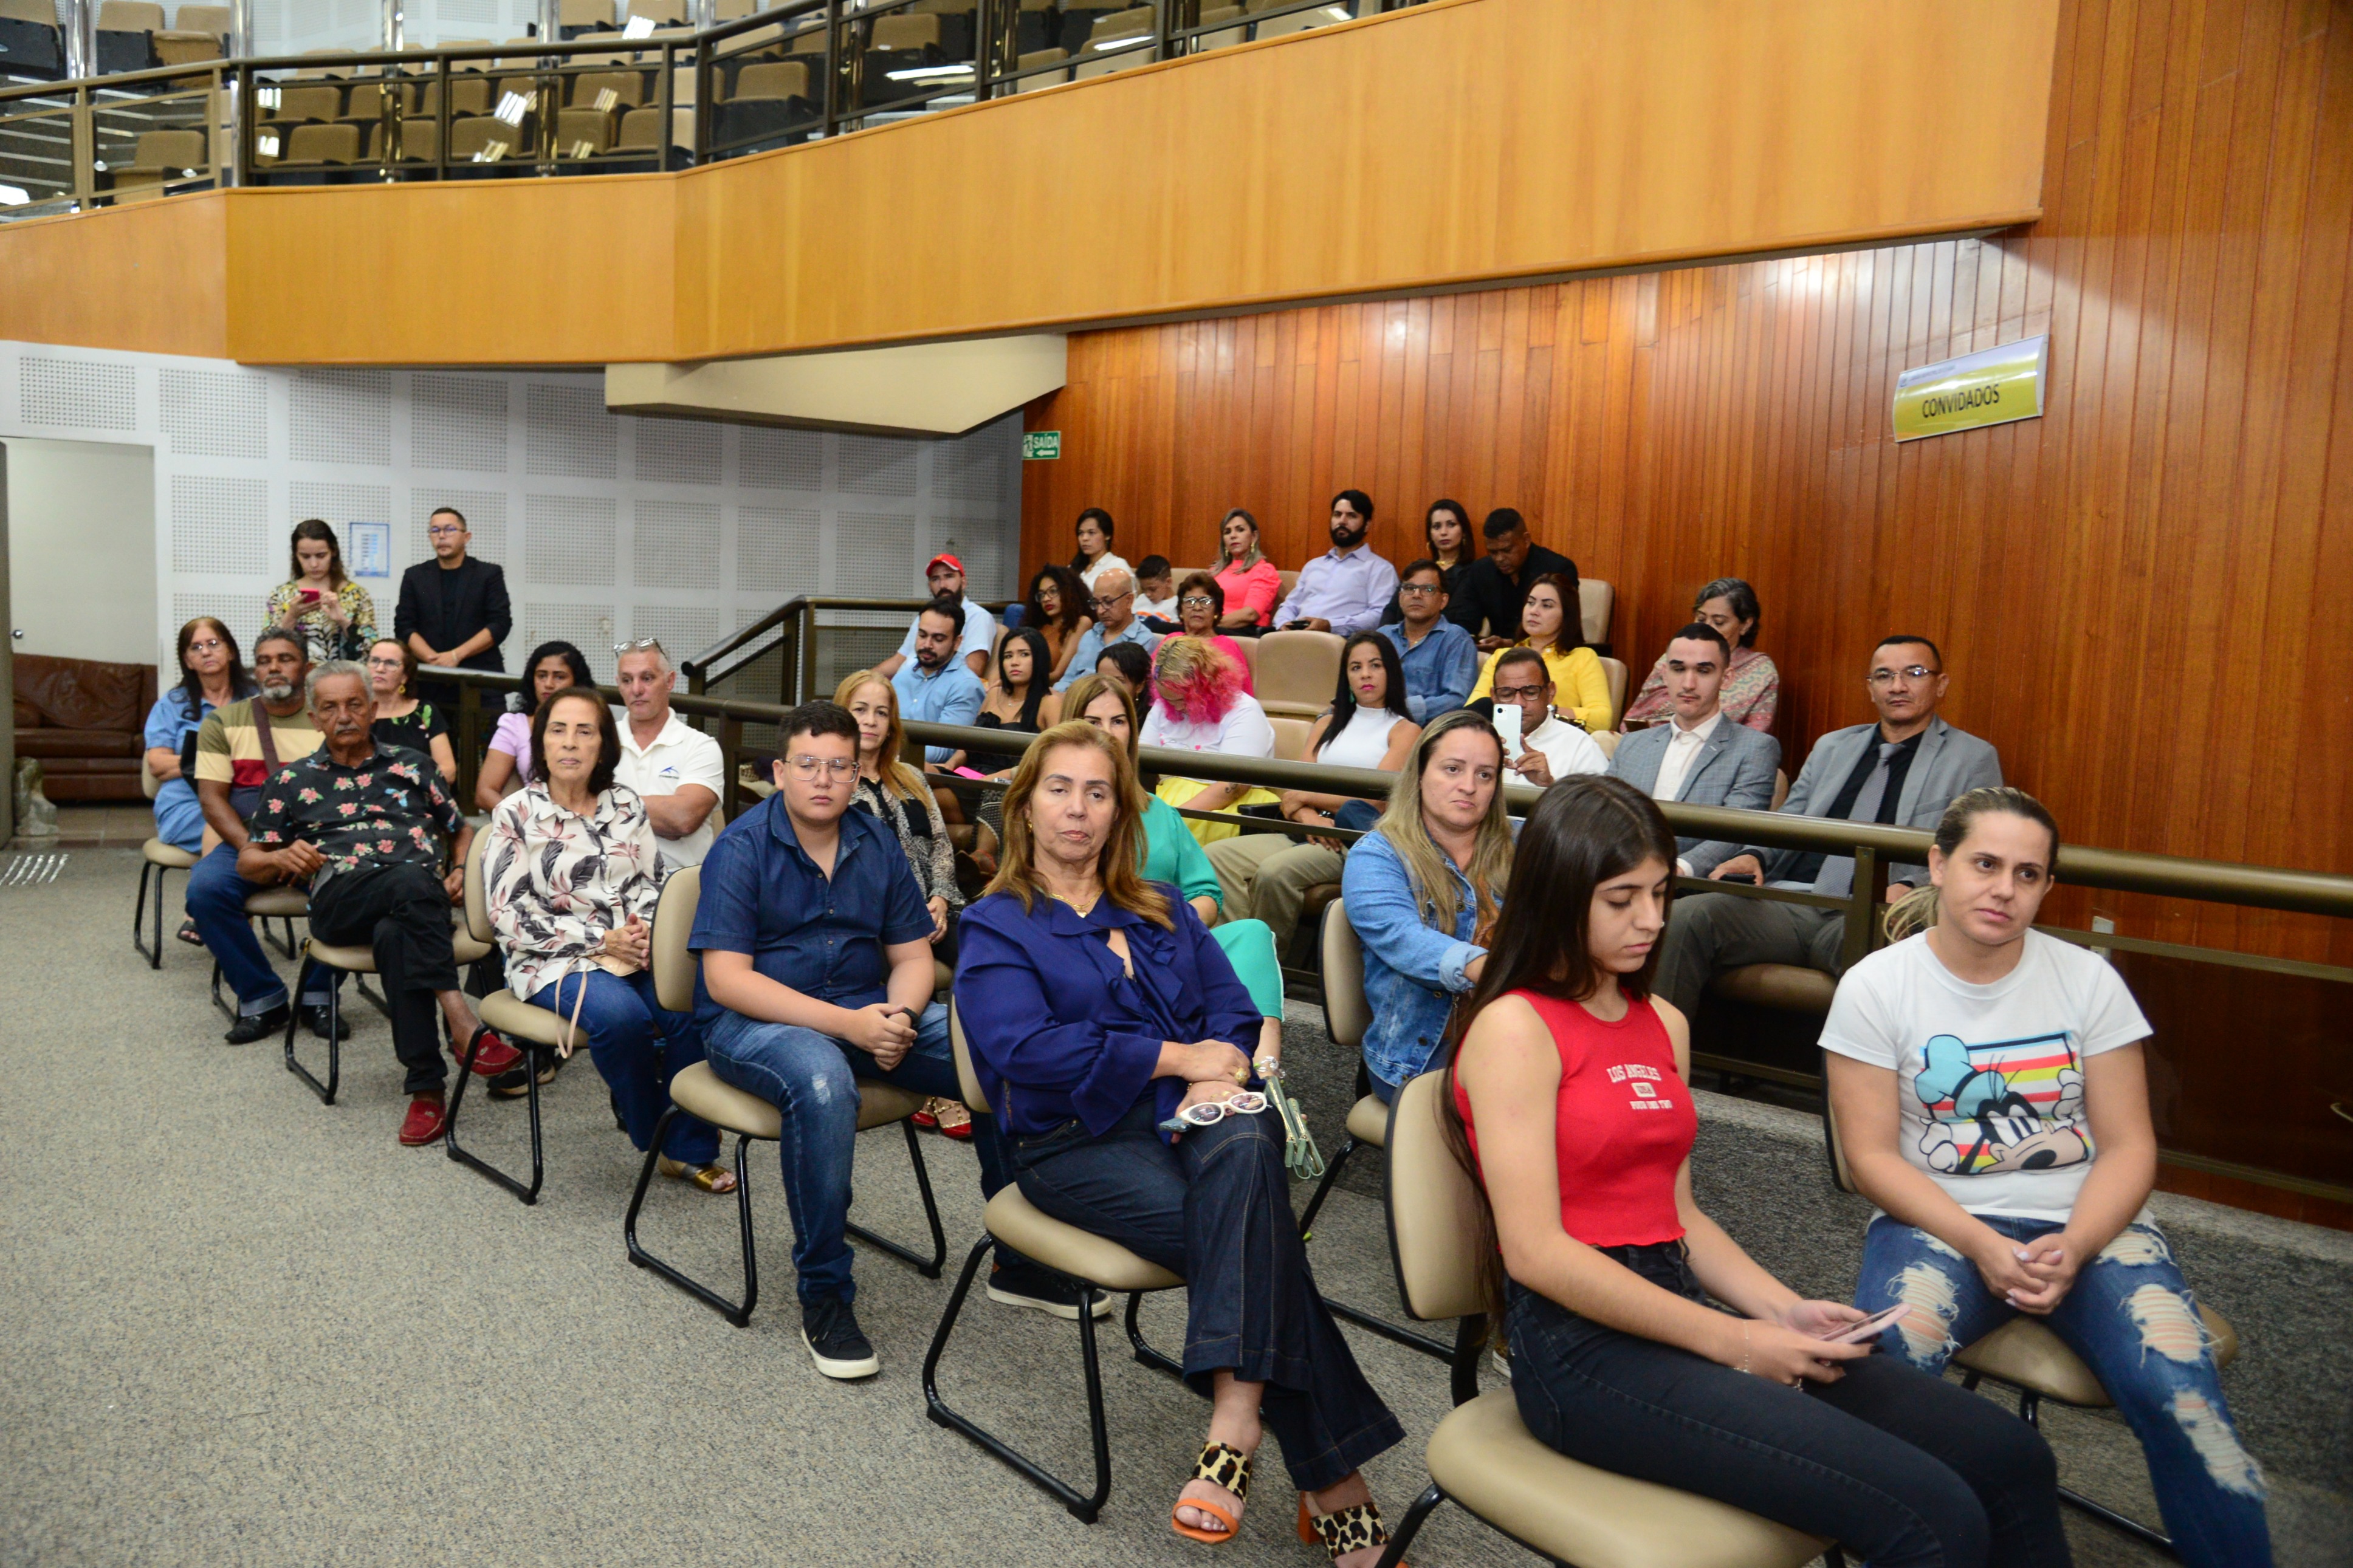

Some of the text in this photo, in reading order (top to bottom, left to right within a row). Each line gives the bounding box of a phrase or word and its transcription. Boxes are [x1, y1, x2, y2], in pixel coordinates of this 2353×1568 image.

[1922, 384, 1999, 418] CONVIDADOS
[1034, 433, 1057, 449] SAÍDA
[1606, 1064, 1662, 1083] LOS ANGELES
